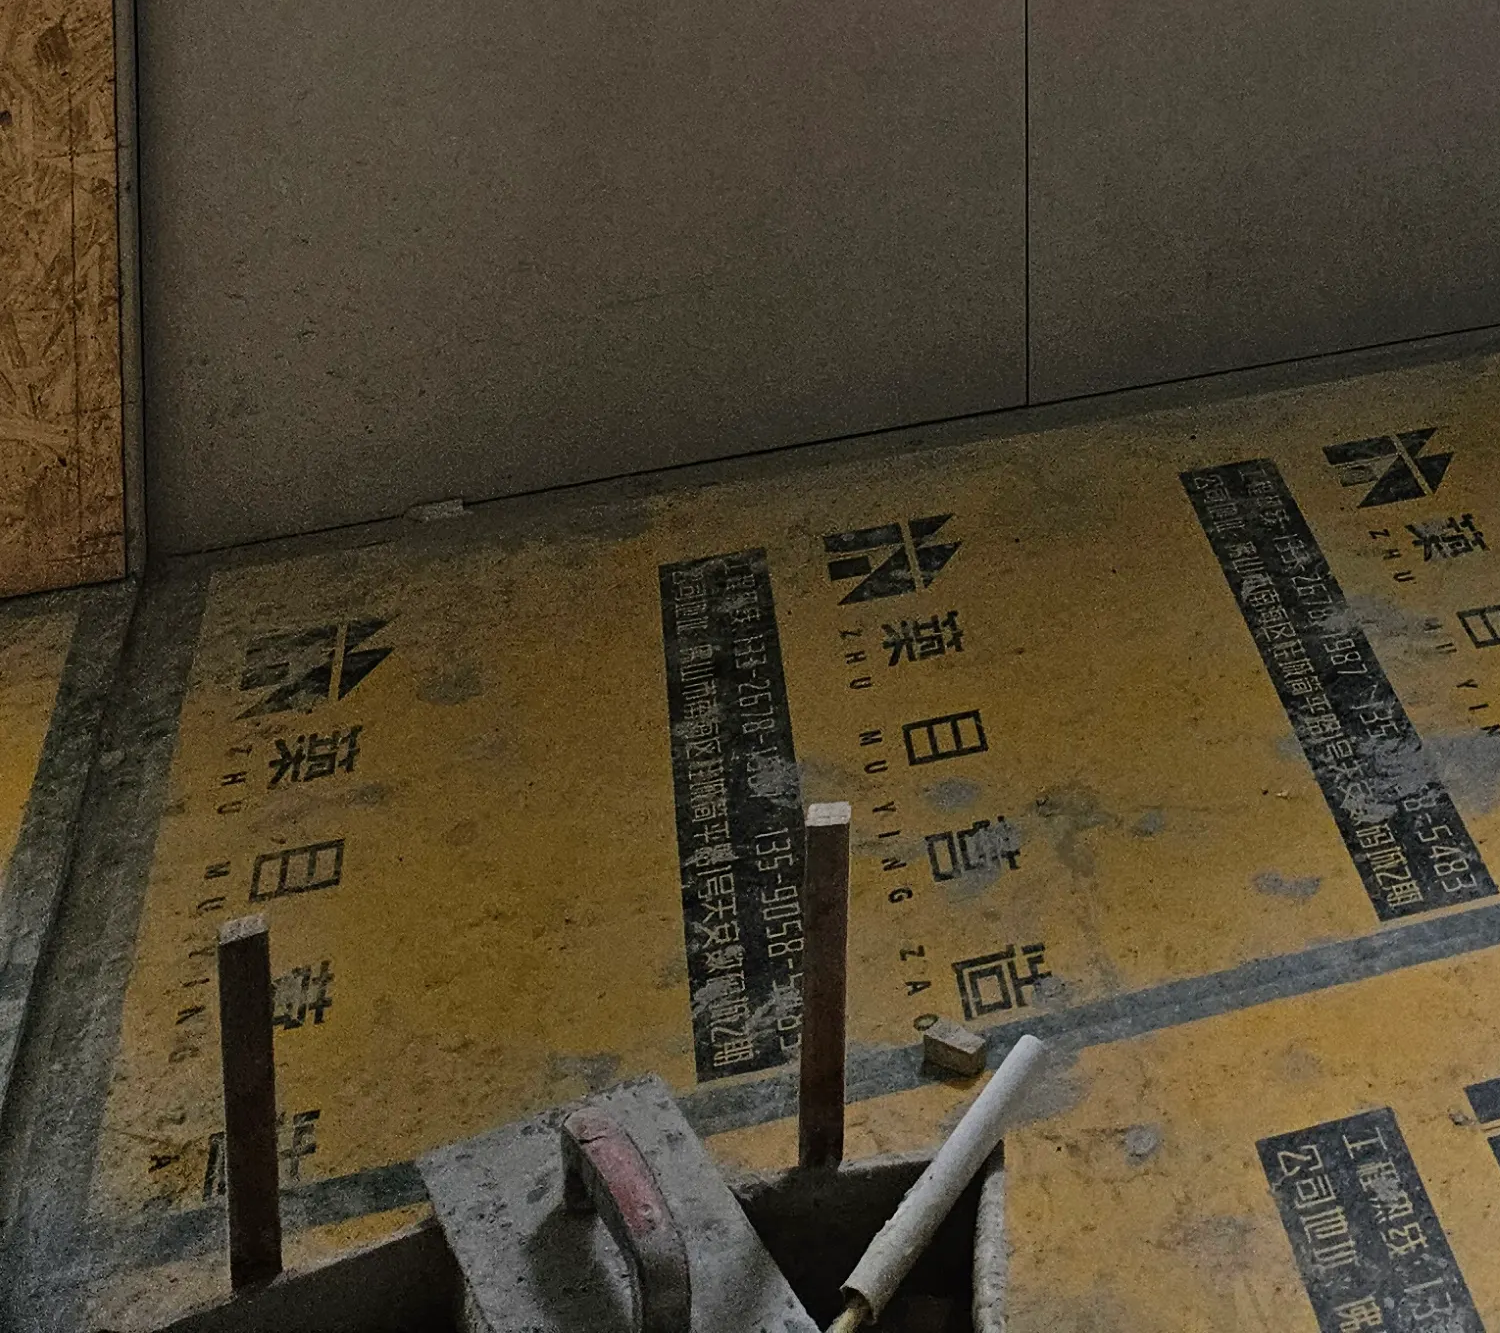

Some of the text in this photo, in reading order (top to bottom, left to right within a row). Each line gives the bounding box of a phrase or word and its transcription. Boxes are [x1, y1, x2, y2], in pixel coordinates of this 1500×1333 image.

[1368, 529, 1417, 584] ZHU
[839, 627, 939, 1032] ZHU MU YING ZAO
[197, 860, 231, 912] MU
